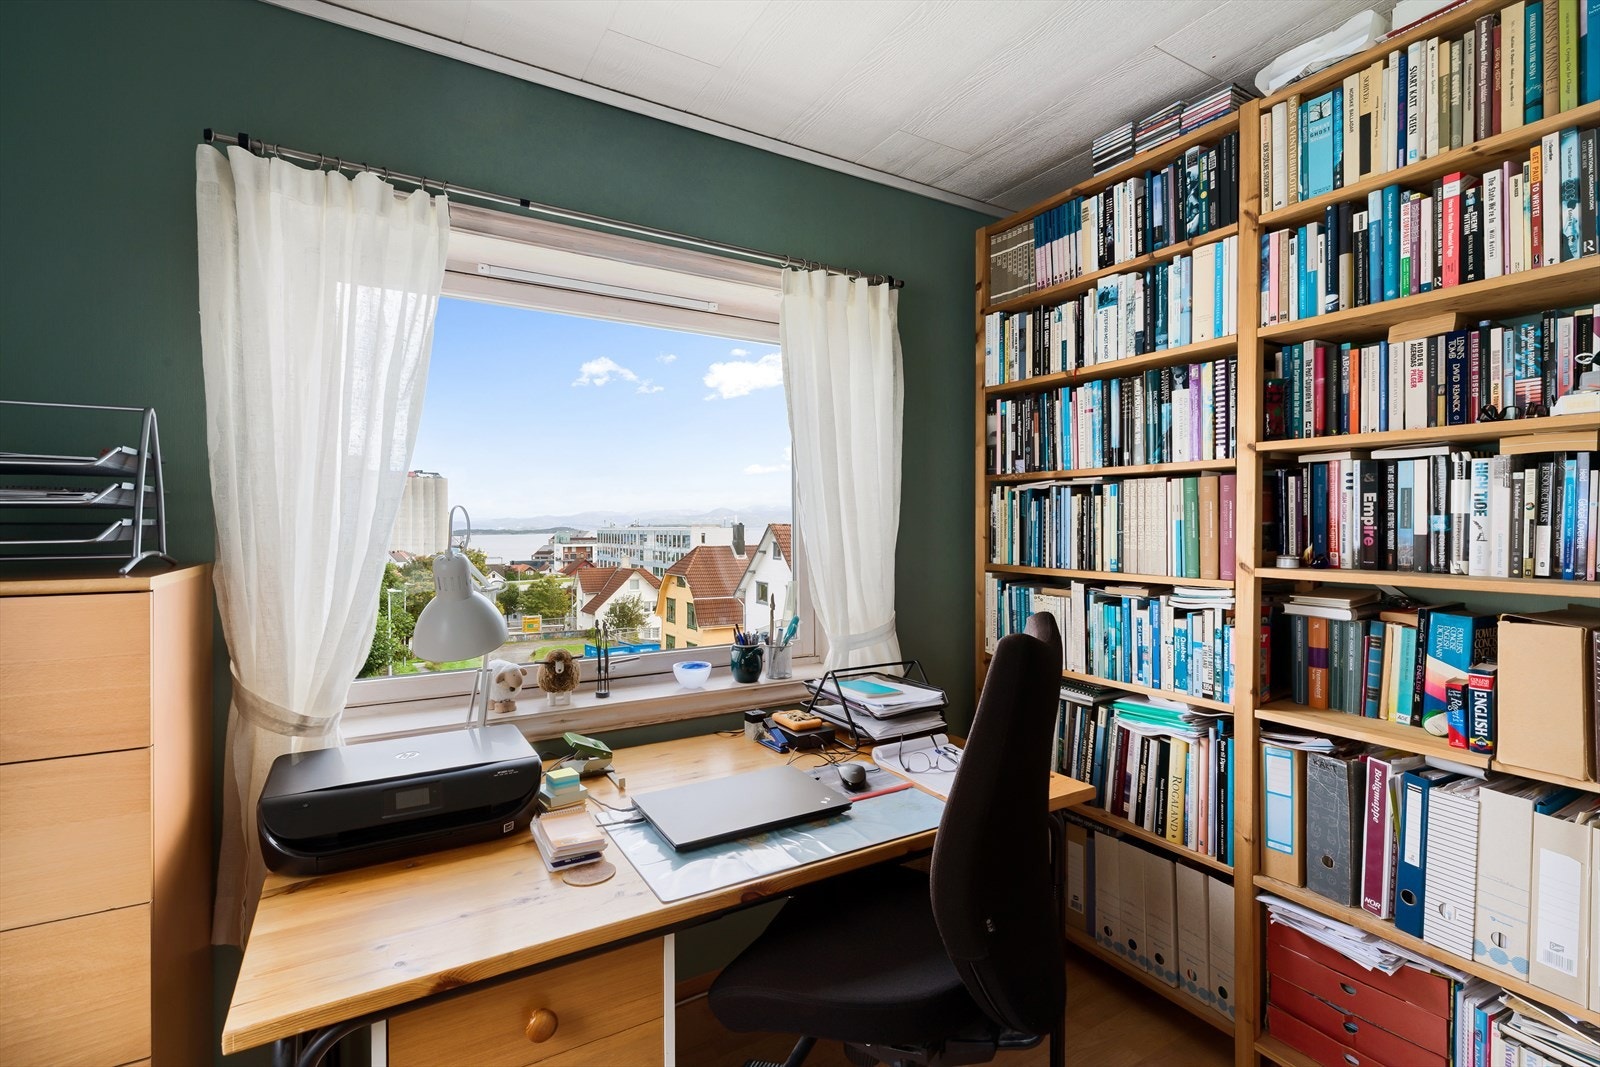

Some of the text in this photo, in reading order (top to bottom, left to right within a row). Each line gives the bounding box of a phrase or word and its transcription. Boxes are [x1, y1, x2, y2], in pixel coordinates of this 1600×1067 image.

[1545, 1, 1559, 86] MANNS MINNE
[1451, 44, 1461, 106] norske eventyr
[1409, 65, 1418, 136] SVART KATT VEIEN
[1289, 96, 1299, 198] NORSK EVENTYRBIBLIOTEK
[1488, 176, 1496, 185] The
[1488, 186, 1496, 202] State
[1532, 183, 1539, 192] TO
[1402, 203, 1410, 216] HOW
[1402, 218, 1410, 245] COMPANIES
[1488, 202, 1496, 217] We're
[1448, 340, 1456, 359] TOMB
[1456, 336, 1464, 360] LENIN'S
[1452, 363, 1460, 413] DAVID REMNICK
[1473, 462, 1489, 516] HIGH TIDE
[1540, 466, 1549, 523] RESOURCE WARS
[1576, 468, 1587, 549] Held Global Covenant
[1361, 492, 1377, 546] Empire
[1436, 624, 1444, 659] DICTIONARY
[1448, 697, 1463, 722] Roget's
[1474, 691, 1488, 736] ENGLISH
[1170, 775, 1183, 832] ROGALAND
[1371, 768, 1382, 823] Boligmappe
[1364, 896, 1381, 908] NOR
